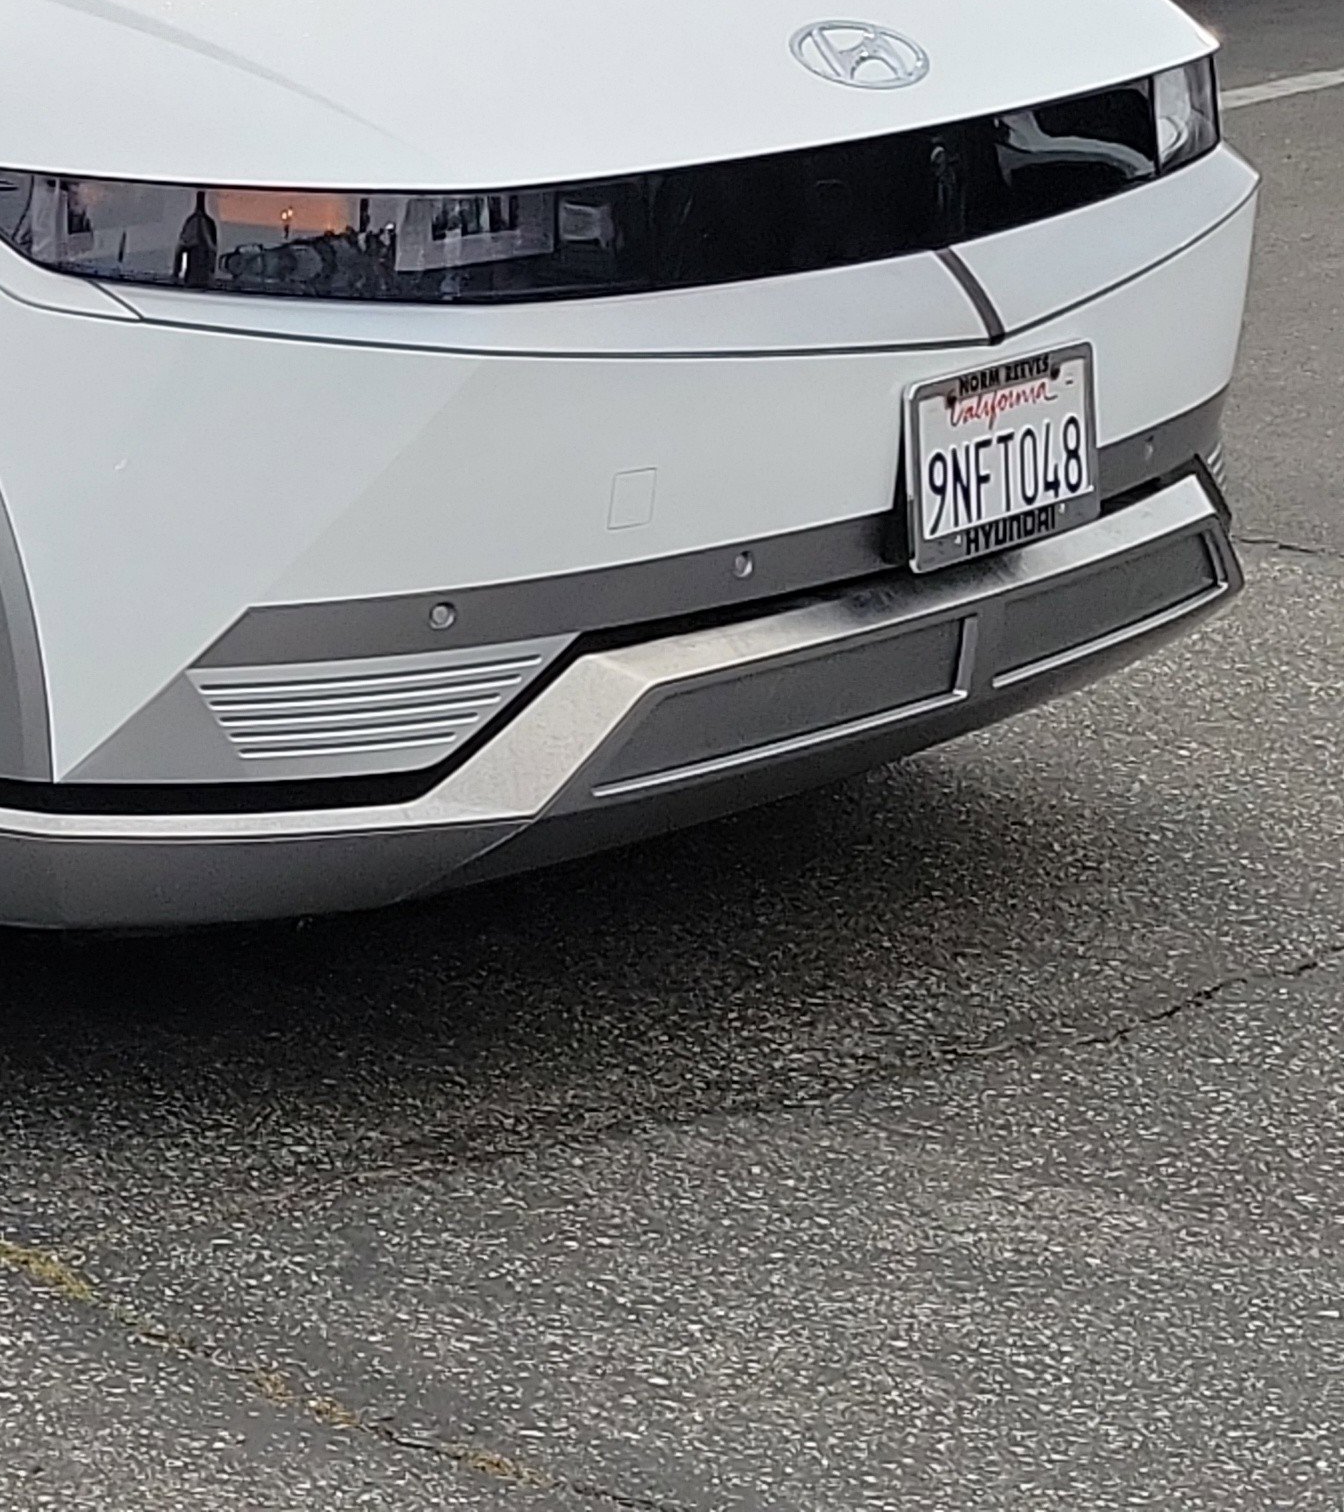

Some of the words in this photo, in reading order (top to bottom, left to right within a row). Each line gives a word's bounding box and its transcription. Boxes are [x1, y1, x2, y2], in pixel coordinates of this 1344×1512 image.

[958, 366, 1001, 396] NORM
[1004, 353, 1050, 383] REEVES
[949, 381, 1058, 431] California
[928, 415, 1084, 536] 9NFT048
[965, 506, 1056, 556] HYUNDAI
